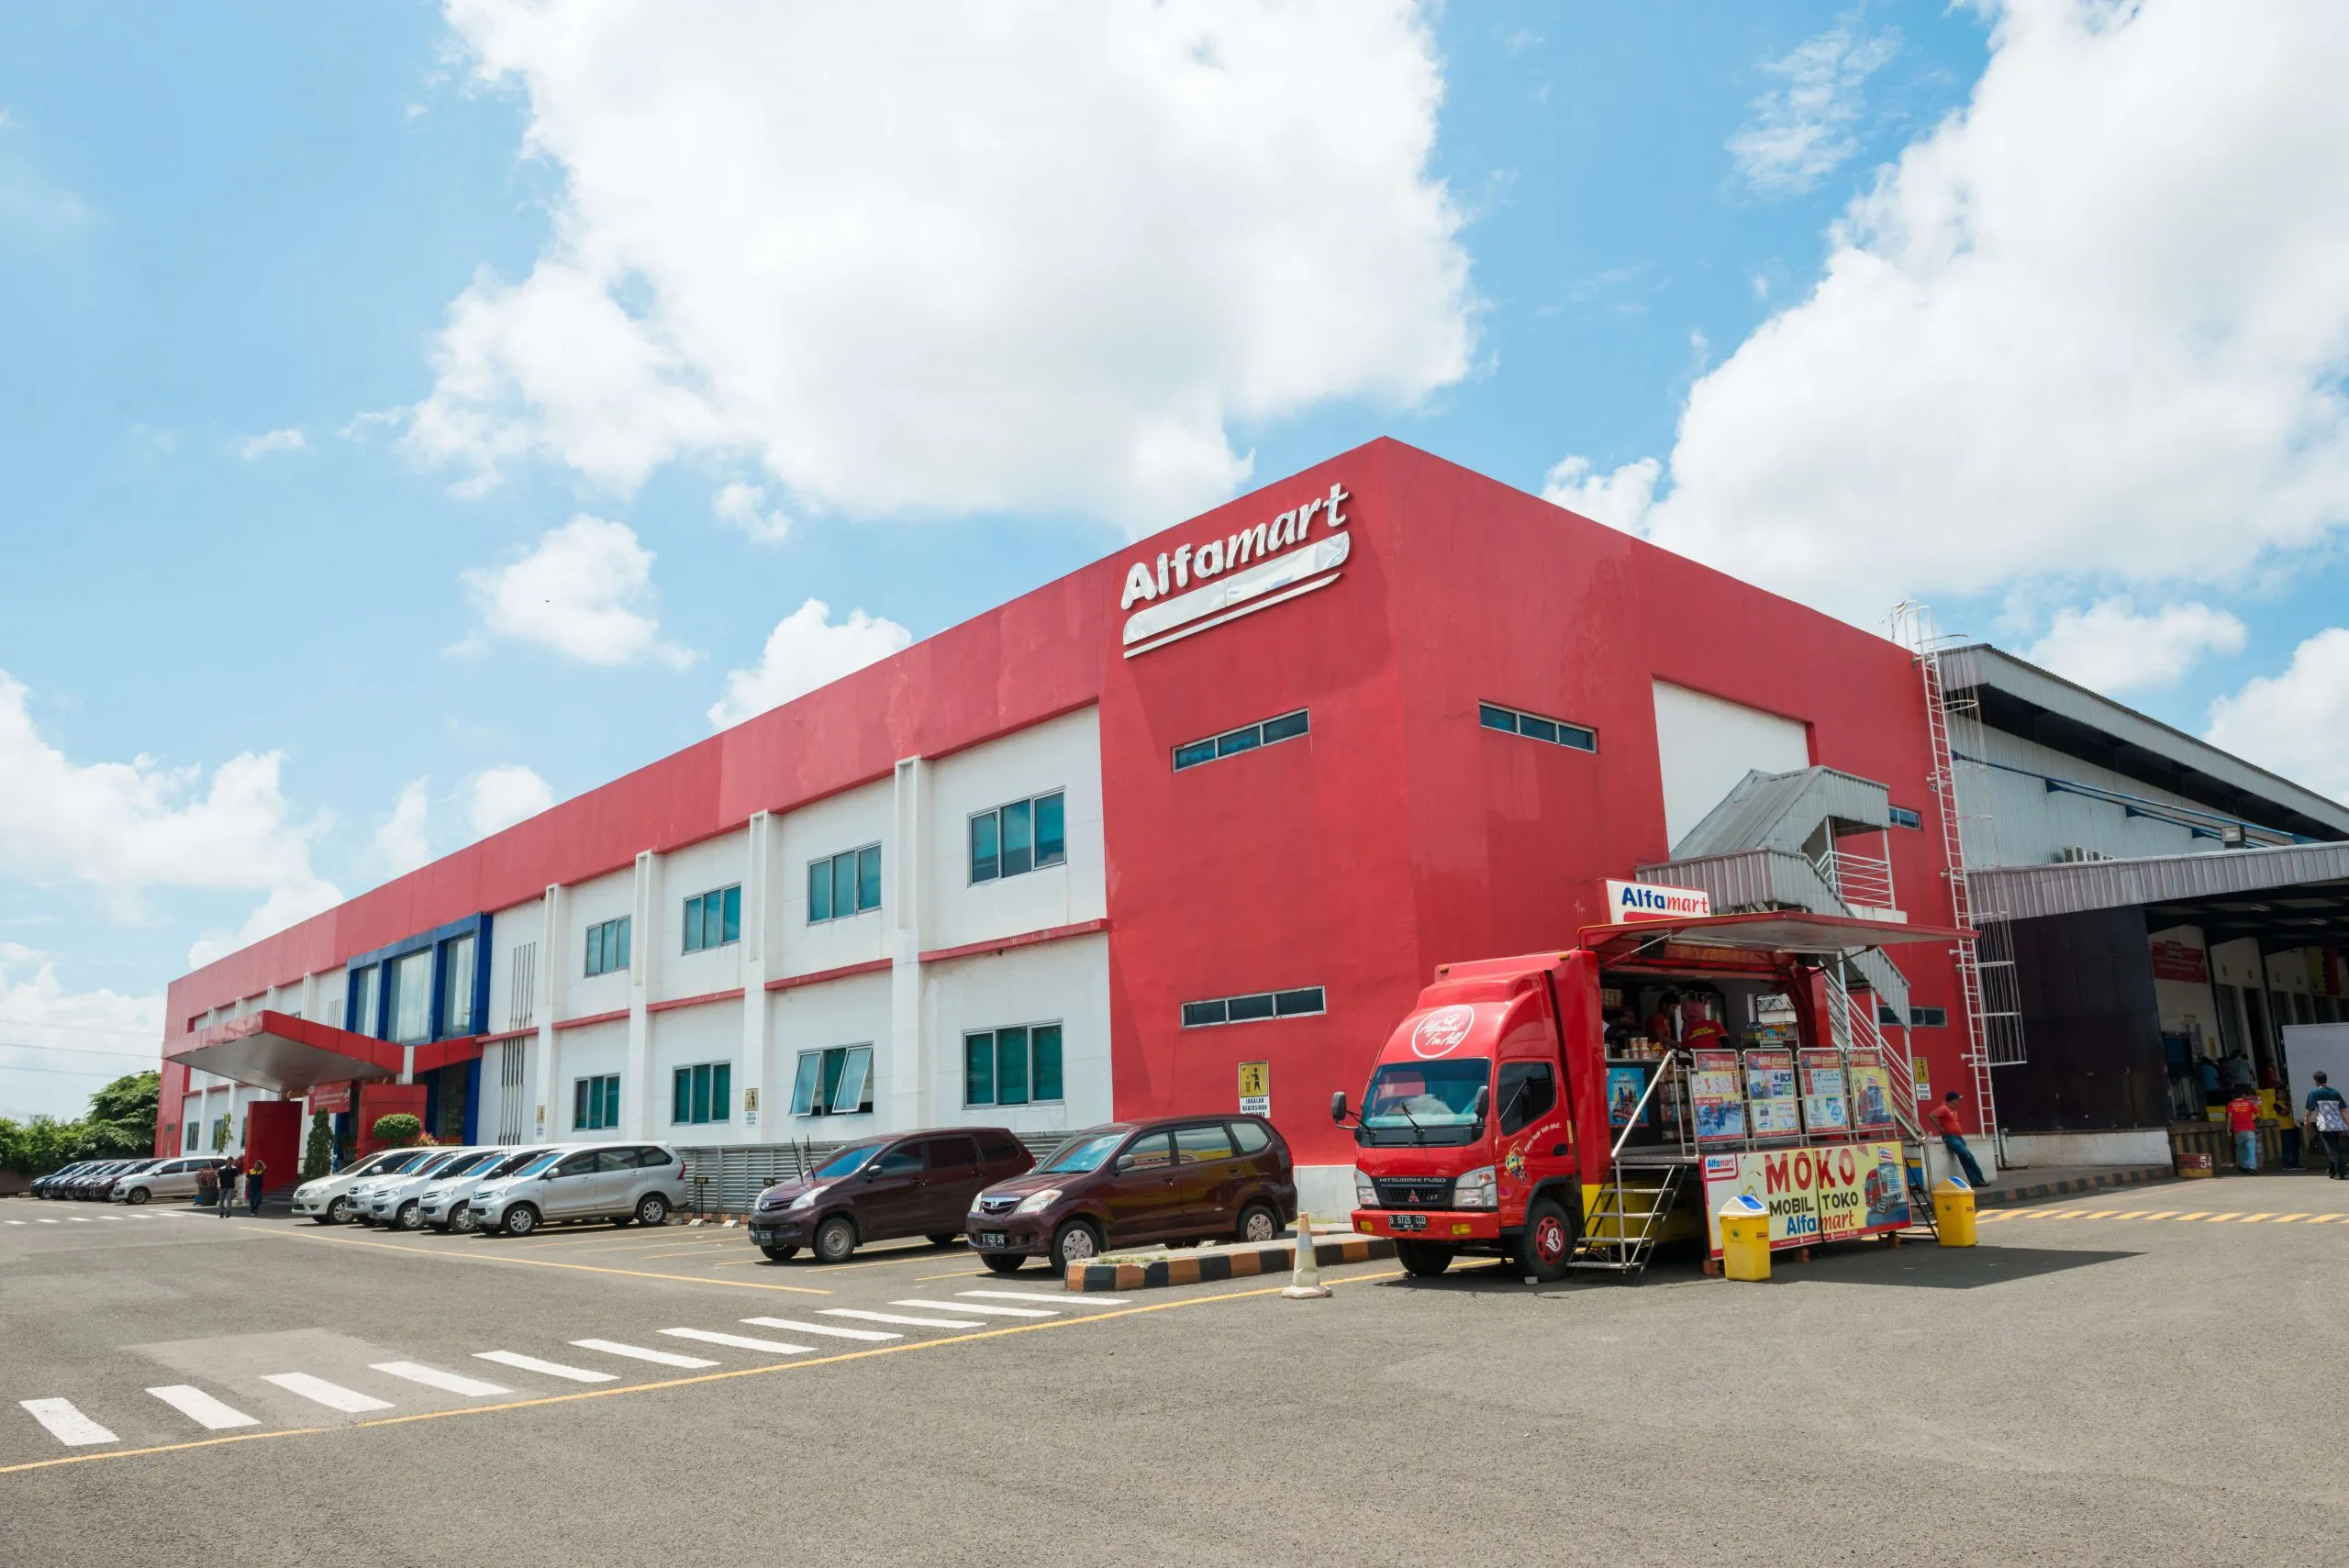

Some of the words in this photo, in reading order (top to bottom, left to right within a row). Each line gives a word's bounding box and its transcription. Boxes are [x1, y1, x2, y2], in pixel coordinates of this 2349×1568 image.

[1120, 483, 1349, 610] Alfamart
[1621, 886, 1709, 914] Alfamart
[1707, 1157, 1734, 1168] Alfamart
[1764, 1148, 1855, 1195] MOKO
[1769, 1195, 1815, 1217] MOBIL
[1821, 1191, 1859, 1211] TOKO
[1388, 1215, 1394, 1224] B
[1786, 1209, 1855, 1236] Alfamart
